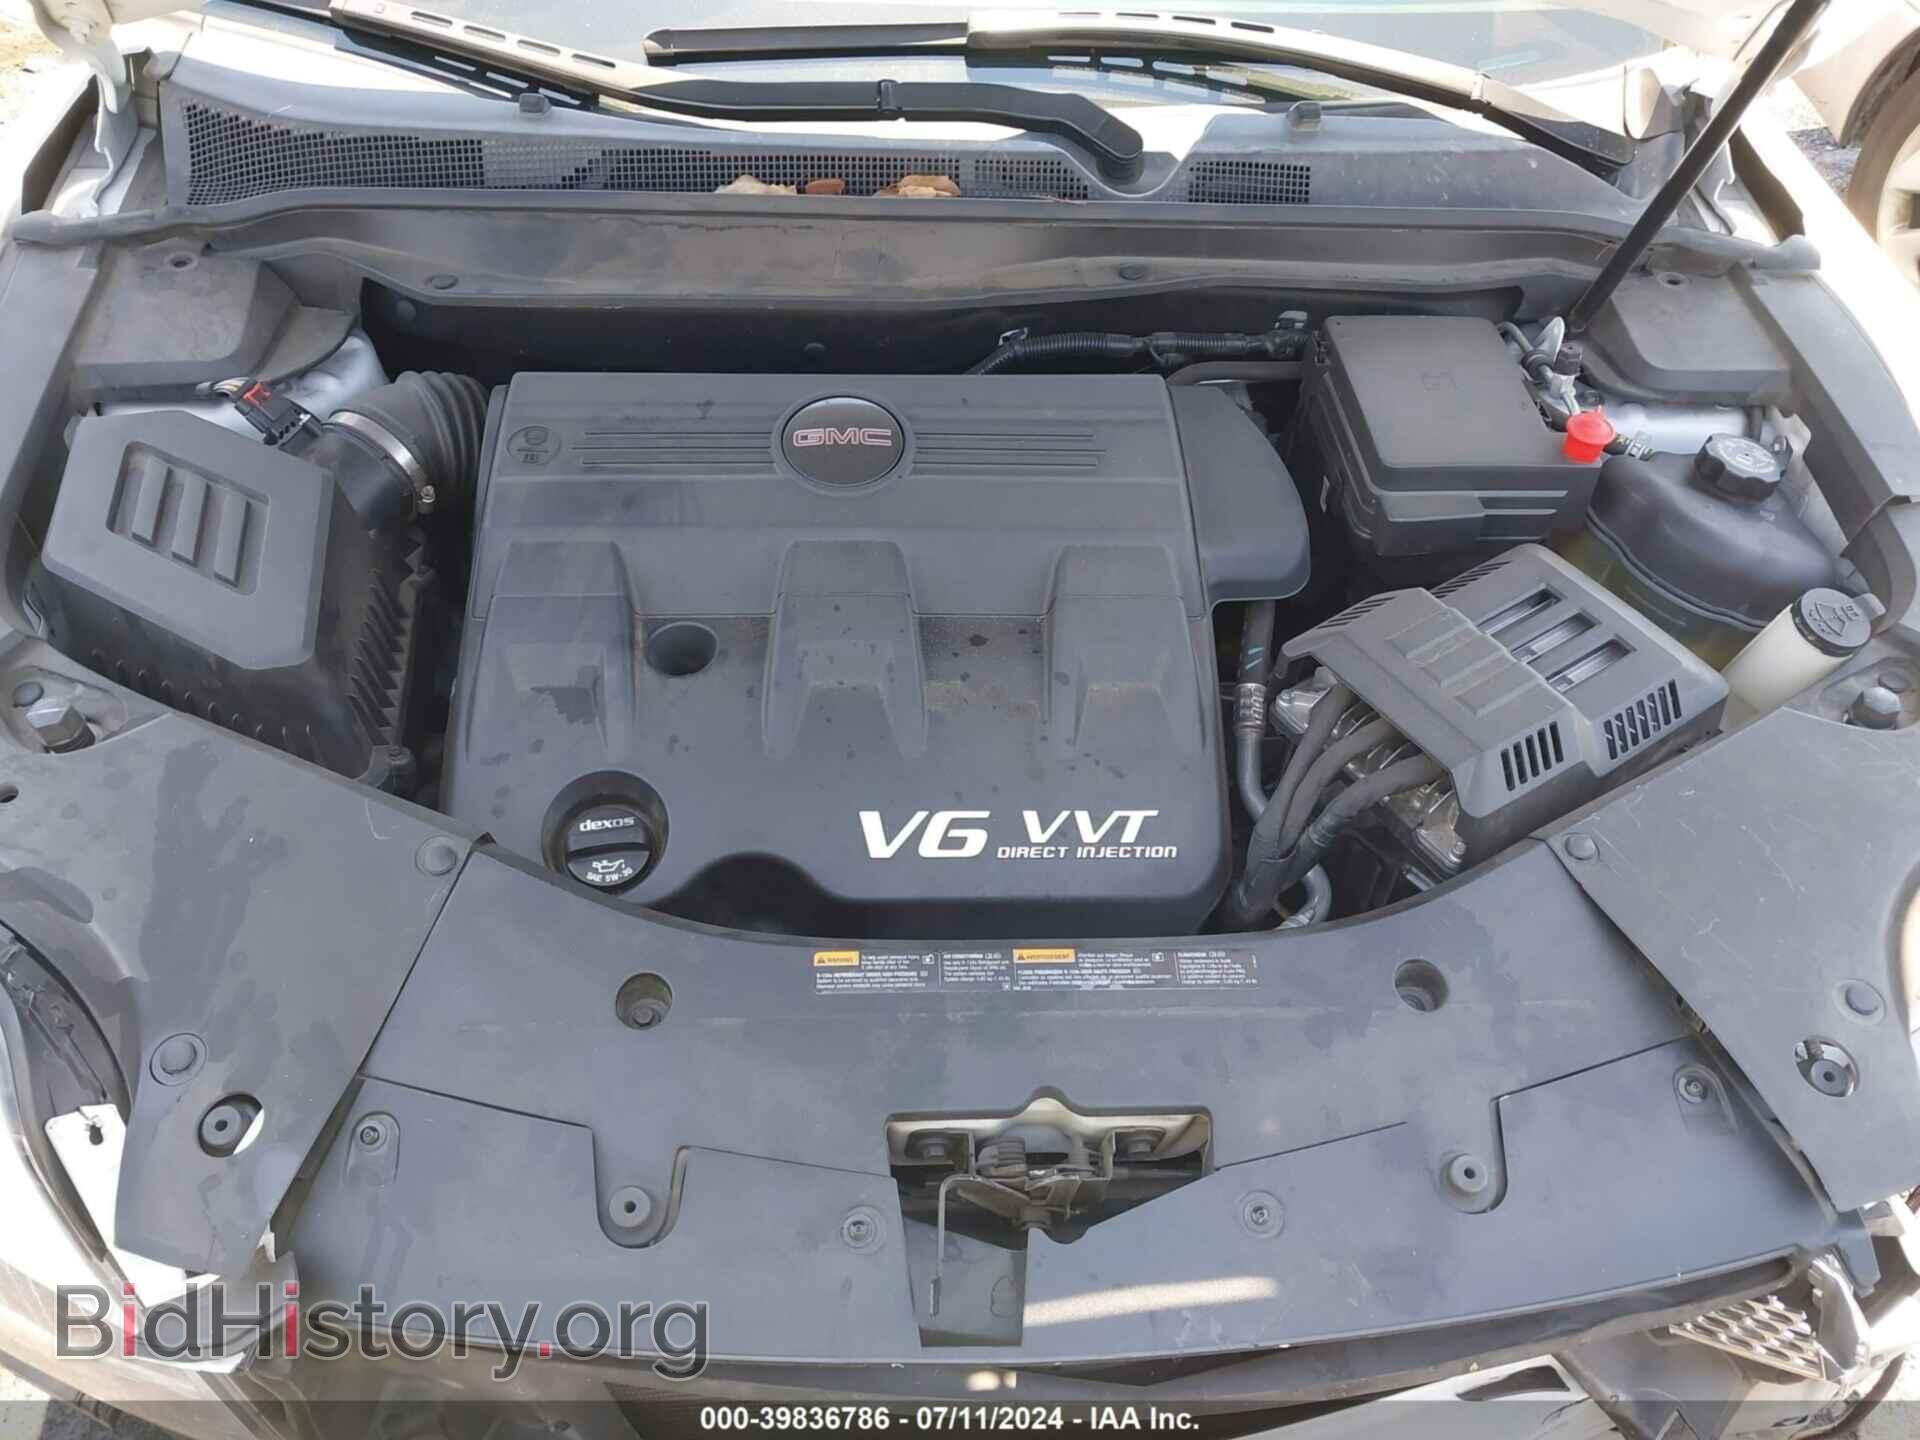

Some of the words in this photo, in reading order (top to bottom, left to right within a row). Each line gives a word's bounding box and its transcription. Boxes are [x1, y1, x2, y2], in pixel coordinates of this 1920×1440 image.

[793, 427, 892, 447] GMC
[579, 816, 635, 832] dexos
[859, 811, 990, 858] V6
[1022, 810, 1159, 843] VVT
[997, 846, 1068, 859] DIRECT
[1076, 846, 1177, 858] INJECTION
[586, 871, 602, 881] SAE
